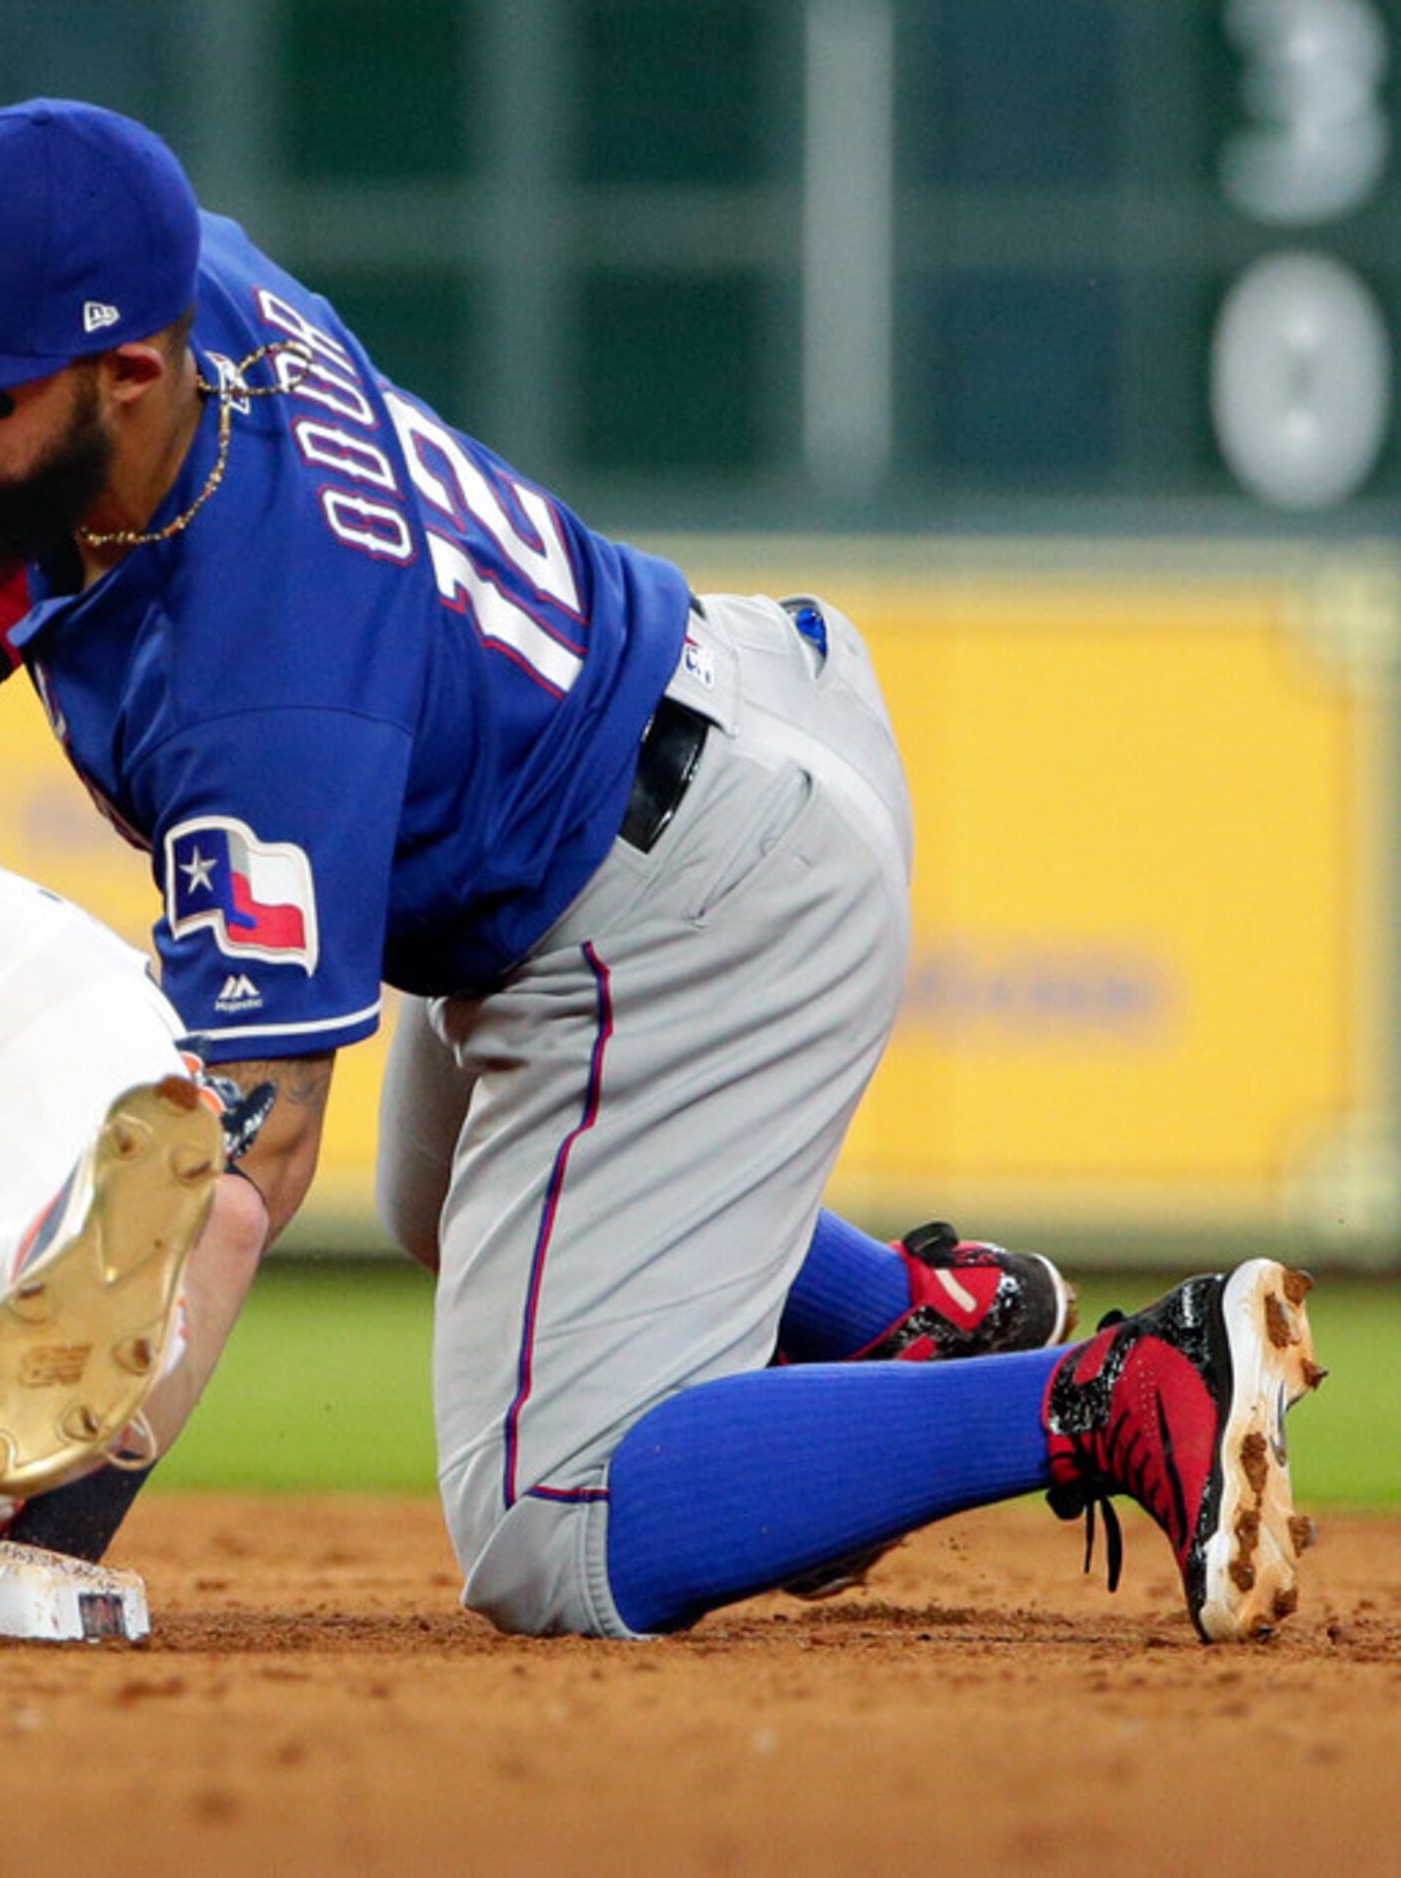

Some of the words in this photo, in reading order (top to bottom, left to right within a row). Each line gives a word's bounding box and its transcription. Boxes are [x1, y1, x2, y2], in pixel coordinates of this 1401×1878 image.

[1223, 0, 1394, 226] 3
[253, 286, 416, 566] ODOR
[1210, 250, 1394, 510] 0
[379, 385, 590, 700] 12
